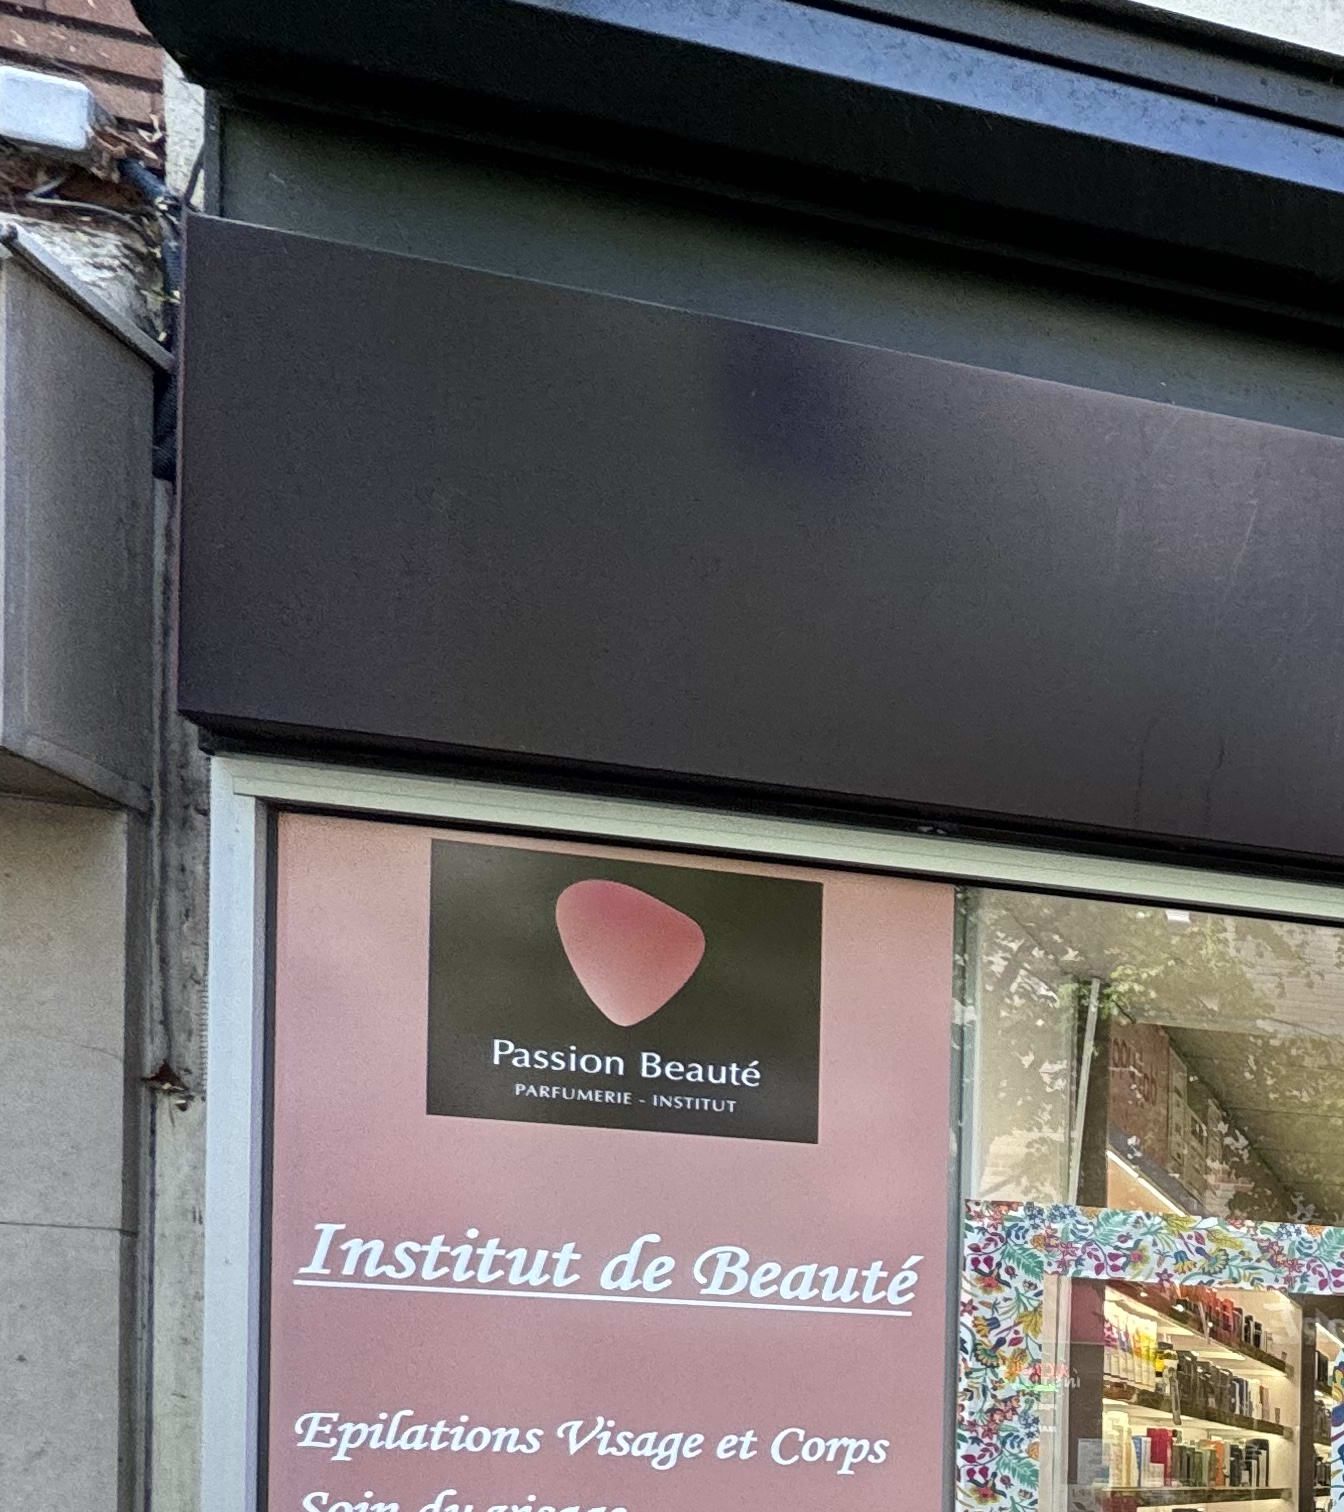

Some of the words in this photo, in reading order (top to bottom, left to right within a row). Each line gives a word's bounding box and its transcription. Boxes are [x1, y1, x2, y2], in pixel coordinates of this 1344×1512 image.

[492, 1038, 625, 1077] Passion
[641, 1050, 762, 1088] Beauté
[514, 1083, 633, 1107] PARFUMERIE
[652, 1094, 737, 1114] INSTITUT
[298, 1222, 582, 1288] Institut
[600, 1233, 674, 1293] de
[692, 1245, 924, 1306] Beauté
[293, 1409, 542, 1462] Epilations
[558, 1419, 705, 1471] Visage
[715, 1427, 758, 1461] et
[768, 1427, 890, 1475] Corps
